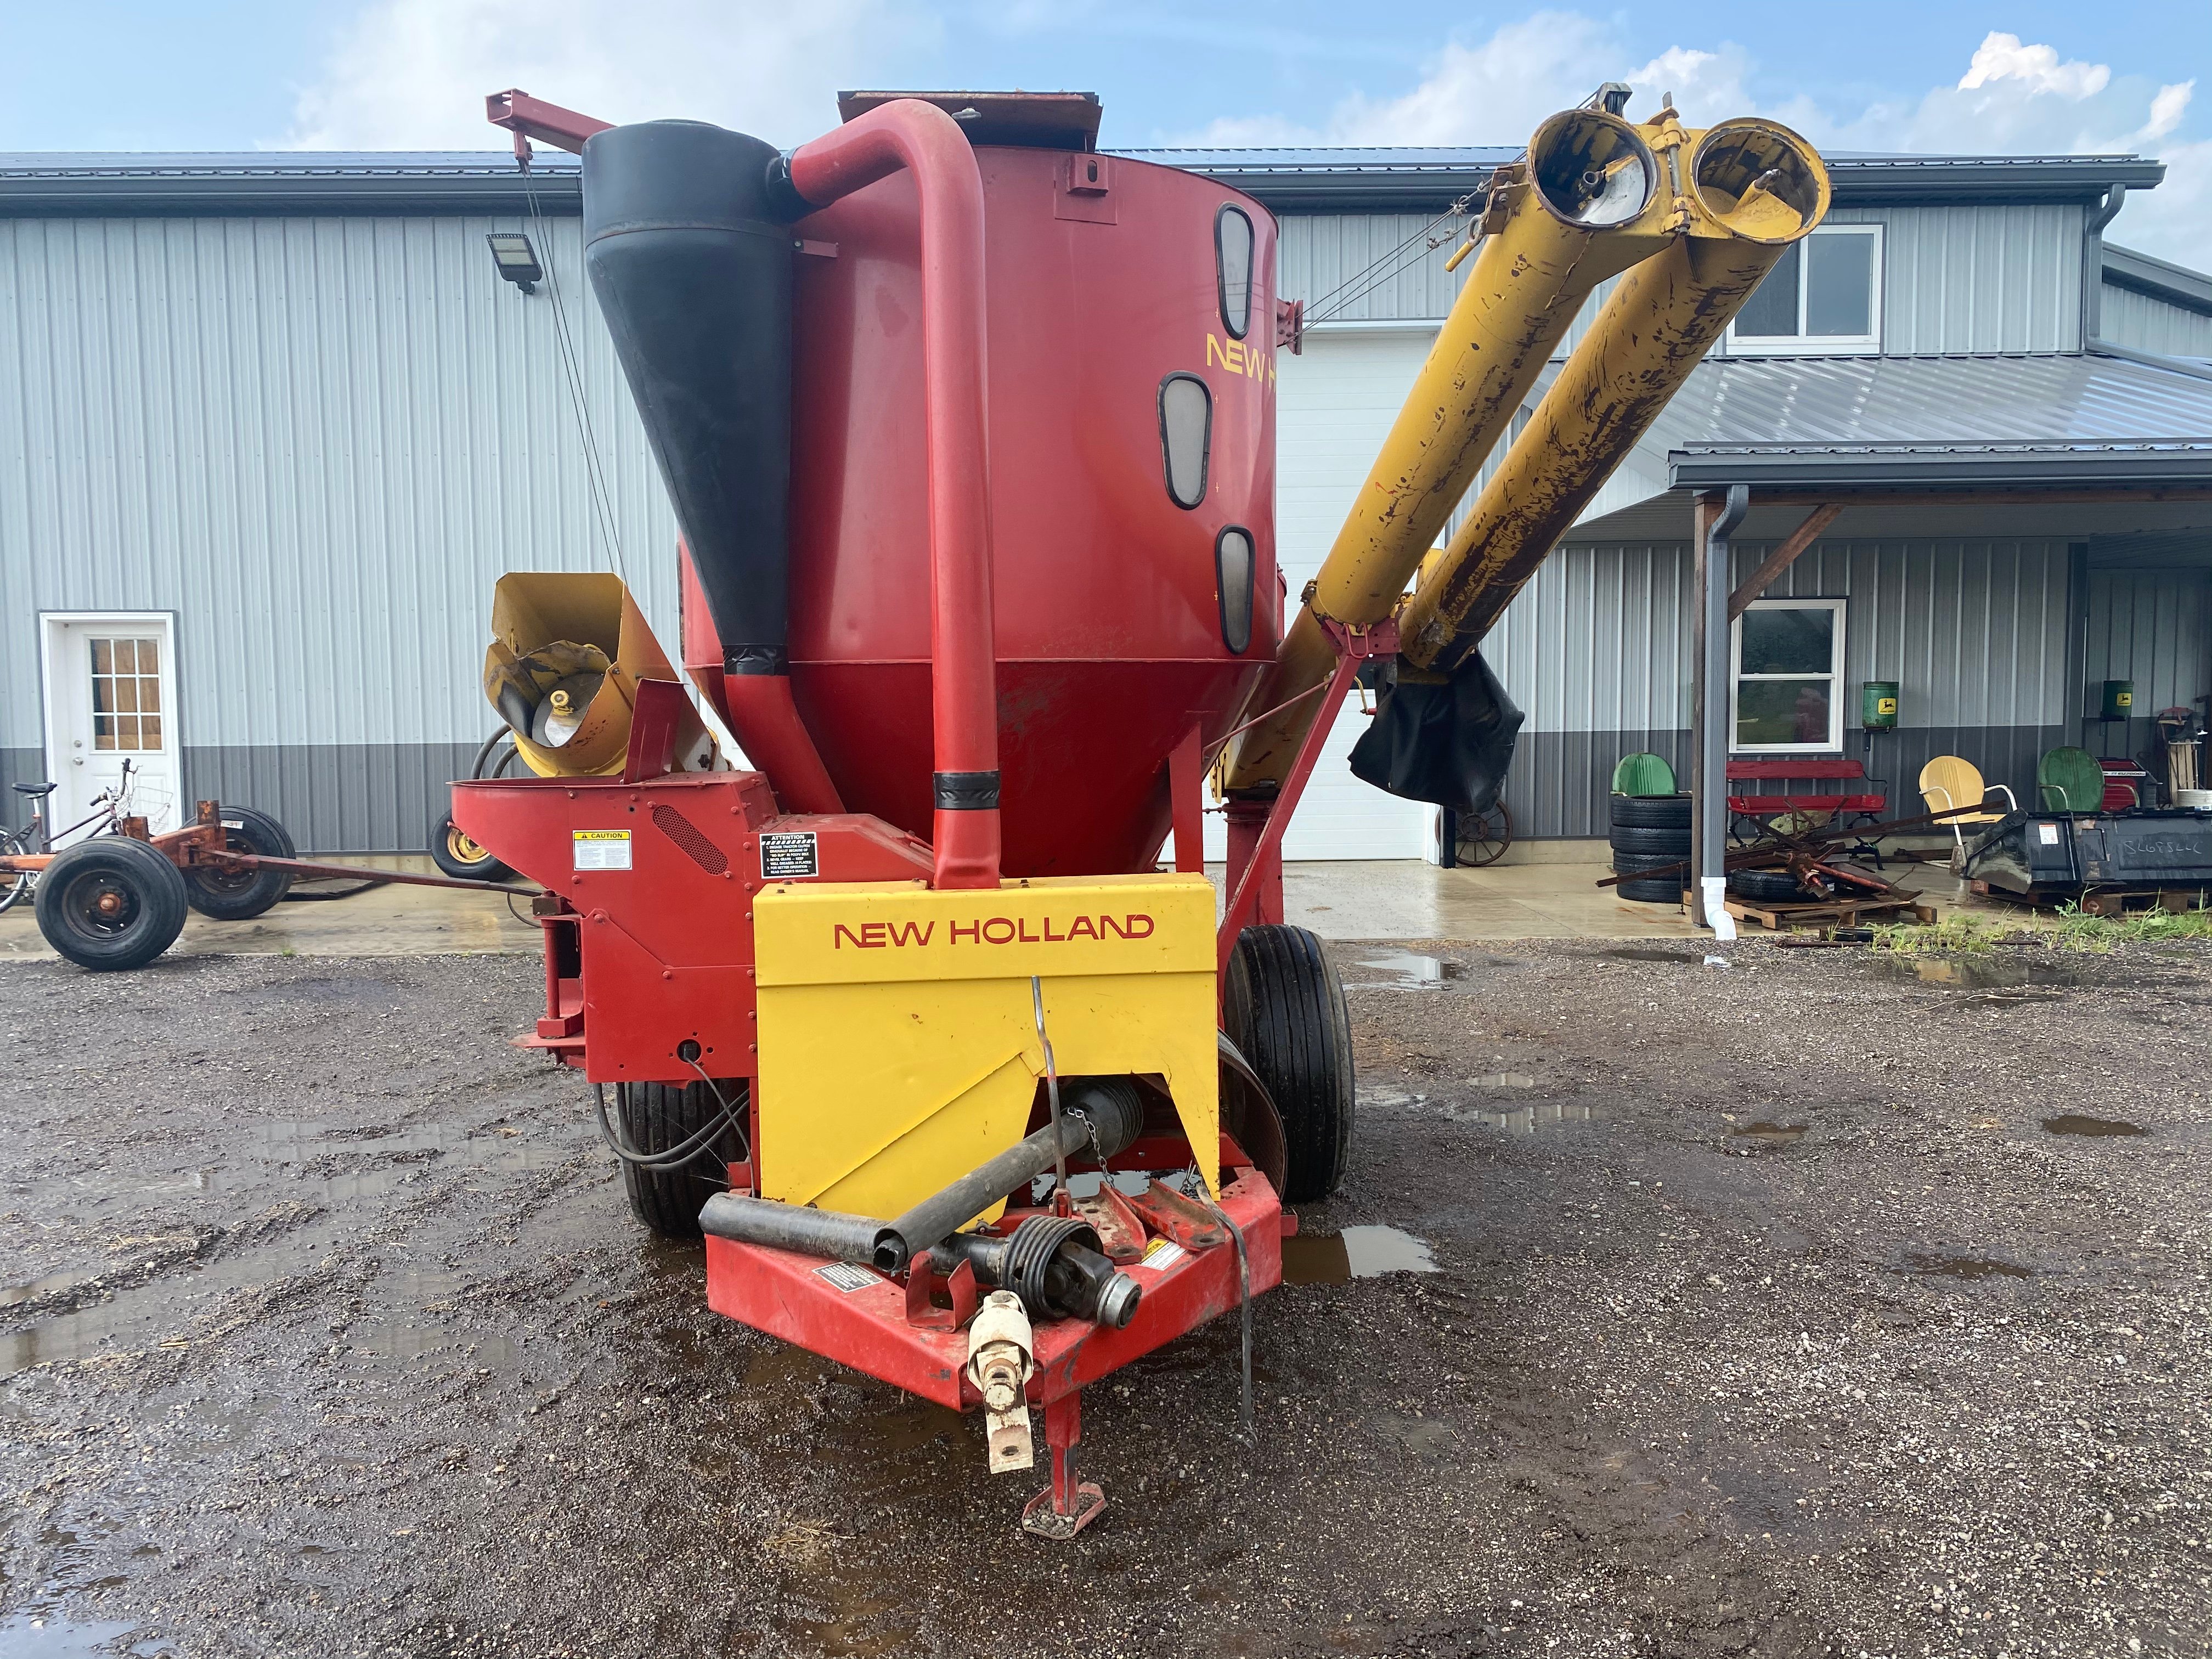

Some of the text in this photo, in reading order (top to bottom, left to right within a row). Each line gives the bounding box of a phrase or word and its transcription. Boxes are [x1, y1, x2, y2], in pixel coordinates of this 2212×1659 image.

[1206, 333, 1266, 382] NEW
[834, 914, 1154, 949] NEW HOLLAND
